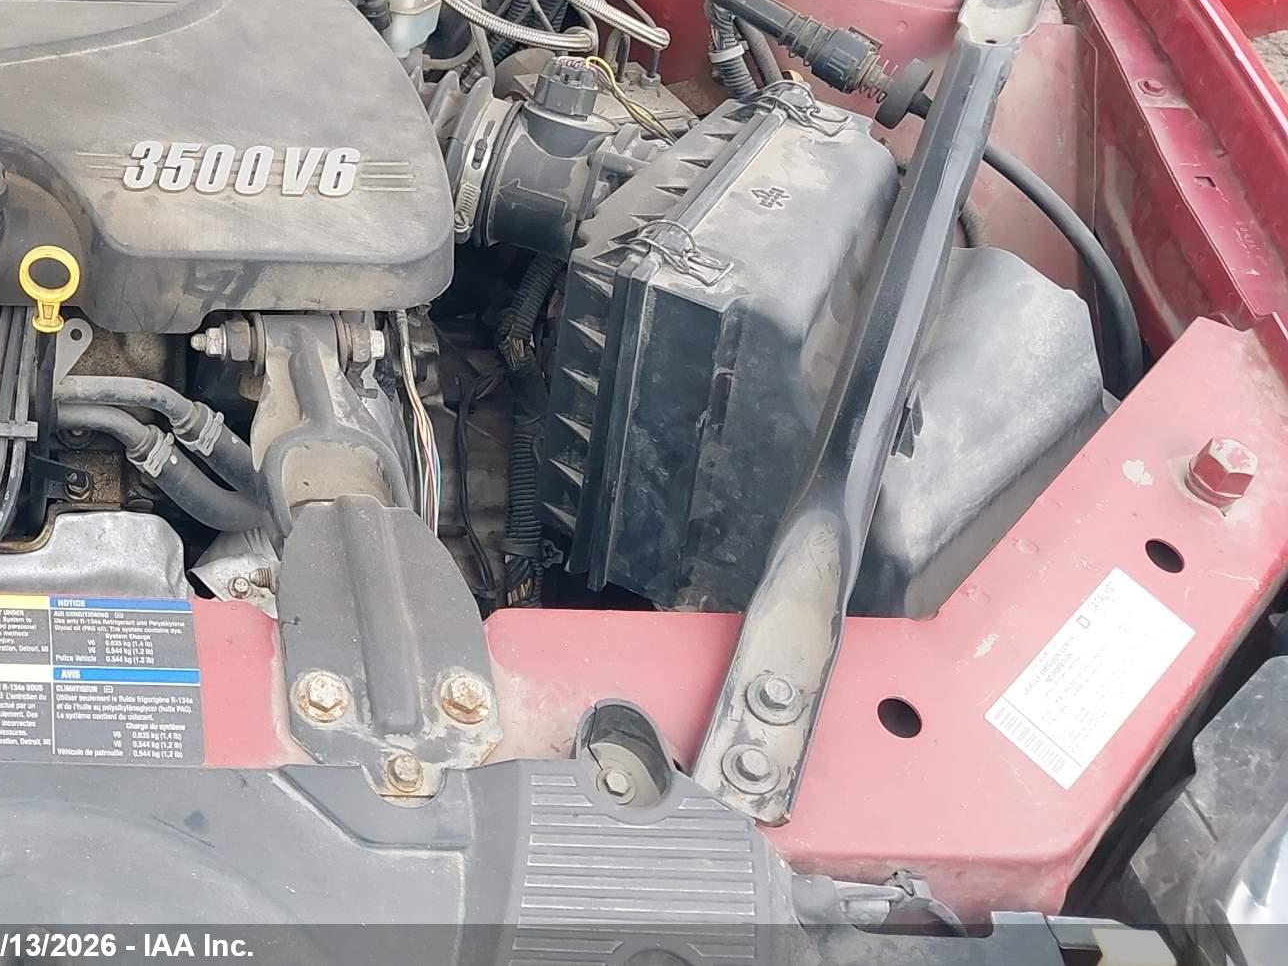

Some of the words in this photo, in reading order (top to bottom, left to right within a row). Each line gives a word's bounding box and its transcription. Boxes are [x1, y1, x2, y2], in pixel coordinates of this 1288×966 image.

[123, 141, 274, 195] 3500
[281, 147, 361, 197] V6
[62, 670, 80, 679] AVIS
